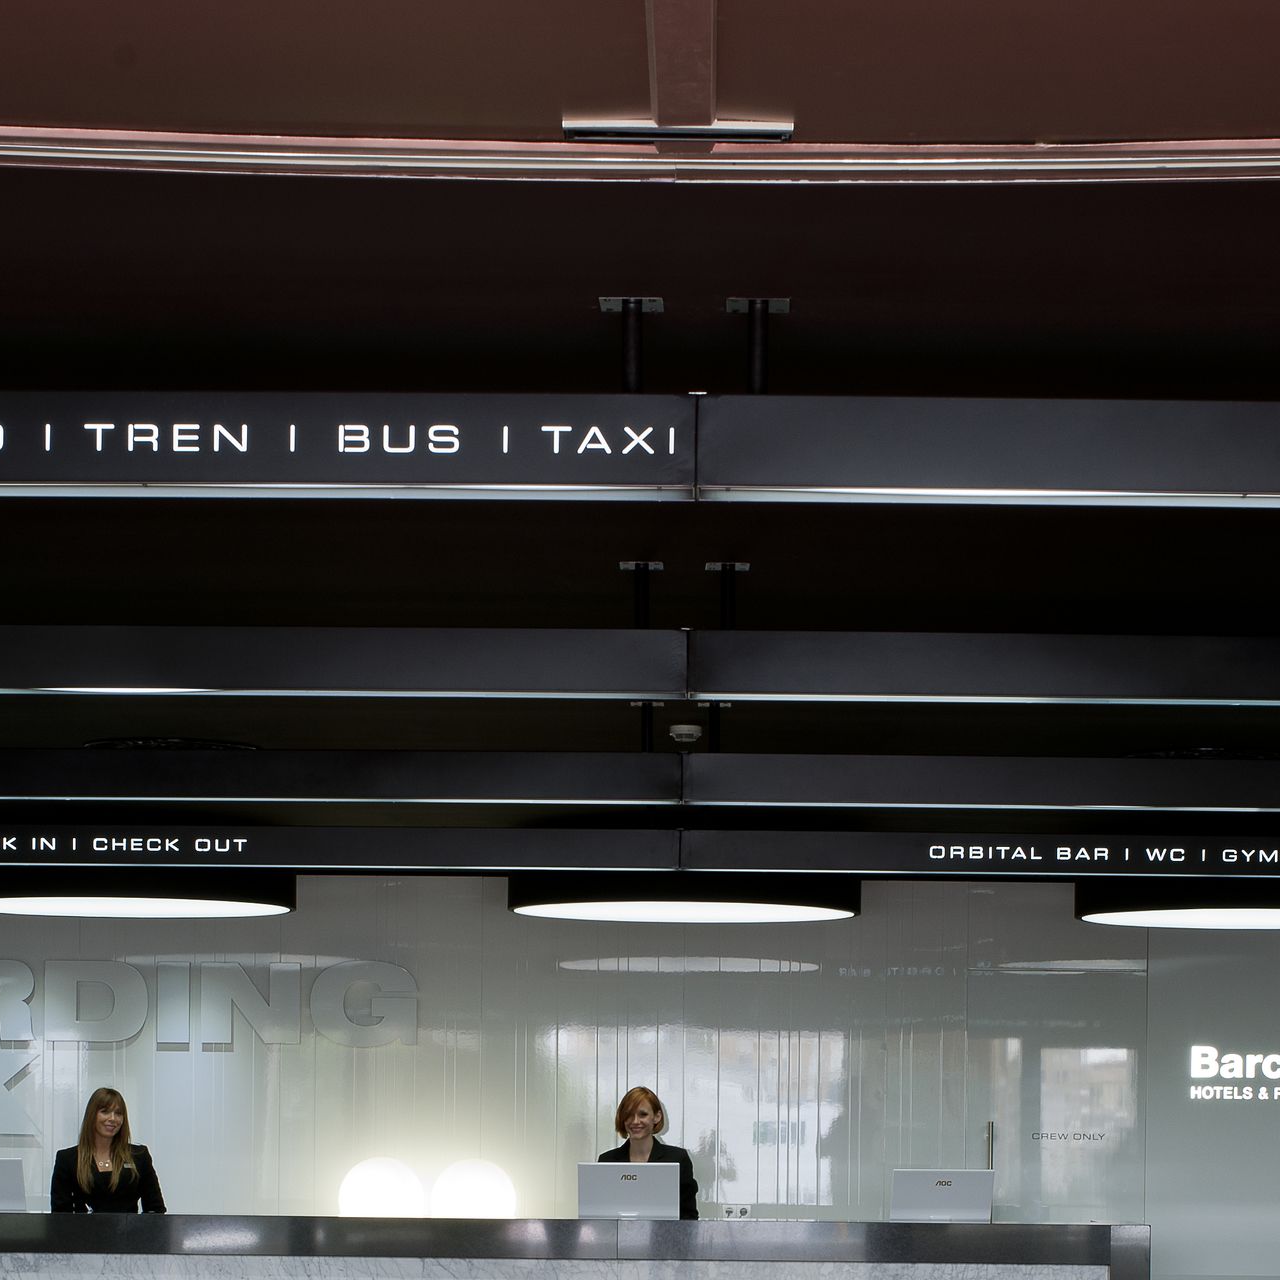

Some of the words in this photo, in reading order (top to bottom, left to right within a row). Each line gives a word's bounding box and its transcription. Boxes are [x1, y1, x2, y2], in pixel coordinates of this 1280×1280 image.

[83, 423, 248, 453] TREN
[338, 424, 460, 454] BUS
[540, 426, 675, 455] TAXI
[31, 837, 56, 851] IN
[92, 837, 180, 852] CHECK
[194, 838, 248, 853] OUT
[929, 845, 1043, 860] ORBITAL
[1056, 846, 1109, 861] BAR
[1145, 847, 1185, 862] WC
[1222, 849, 1279, 863] GYM
[1189, 1085, 1254, 1101] HOTELS
[1257, 1086, 1269, 1101] &
[1031, 1132, 1069, 1141] CREW
[1072, 1132, 1106, 1141] ONLY
